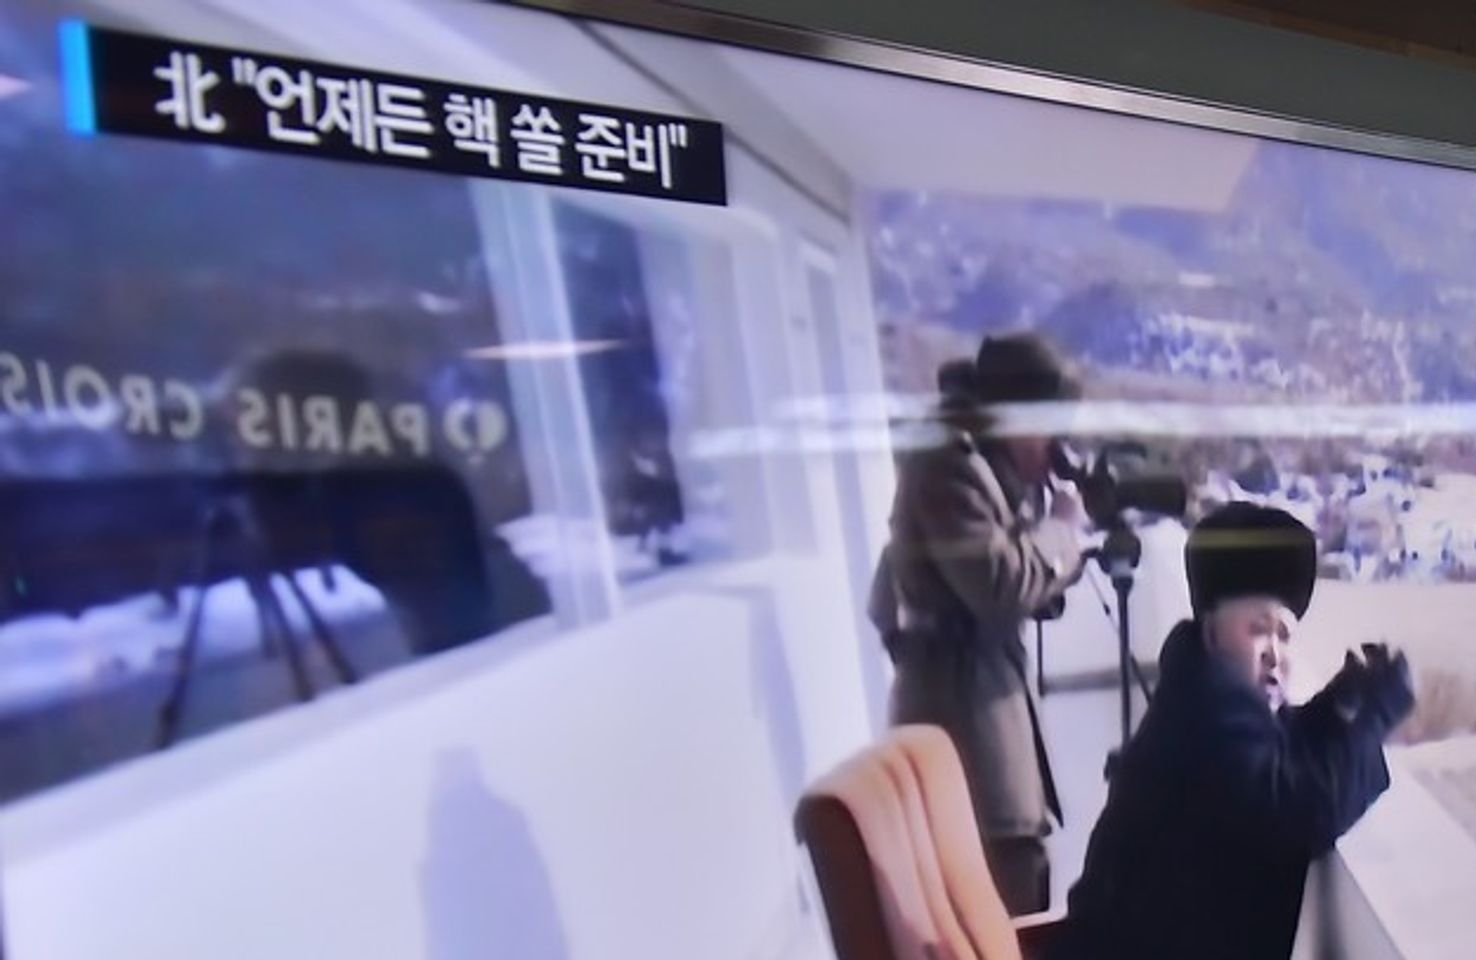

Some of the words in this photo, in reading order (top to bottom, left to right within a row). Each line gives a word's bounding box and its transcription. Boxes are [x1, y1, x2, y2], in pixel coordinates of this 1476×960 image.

[155, 51, 226, 134] 北
[231, 56, 433, 158] "언제든
[443, 93, 501, 168] 핵
[510, 104, 564, 176] 쏠
[575, 113, 687, 189] 준비"
